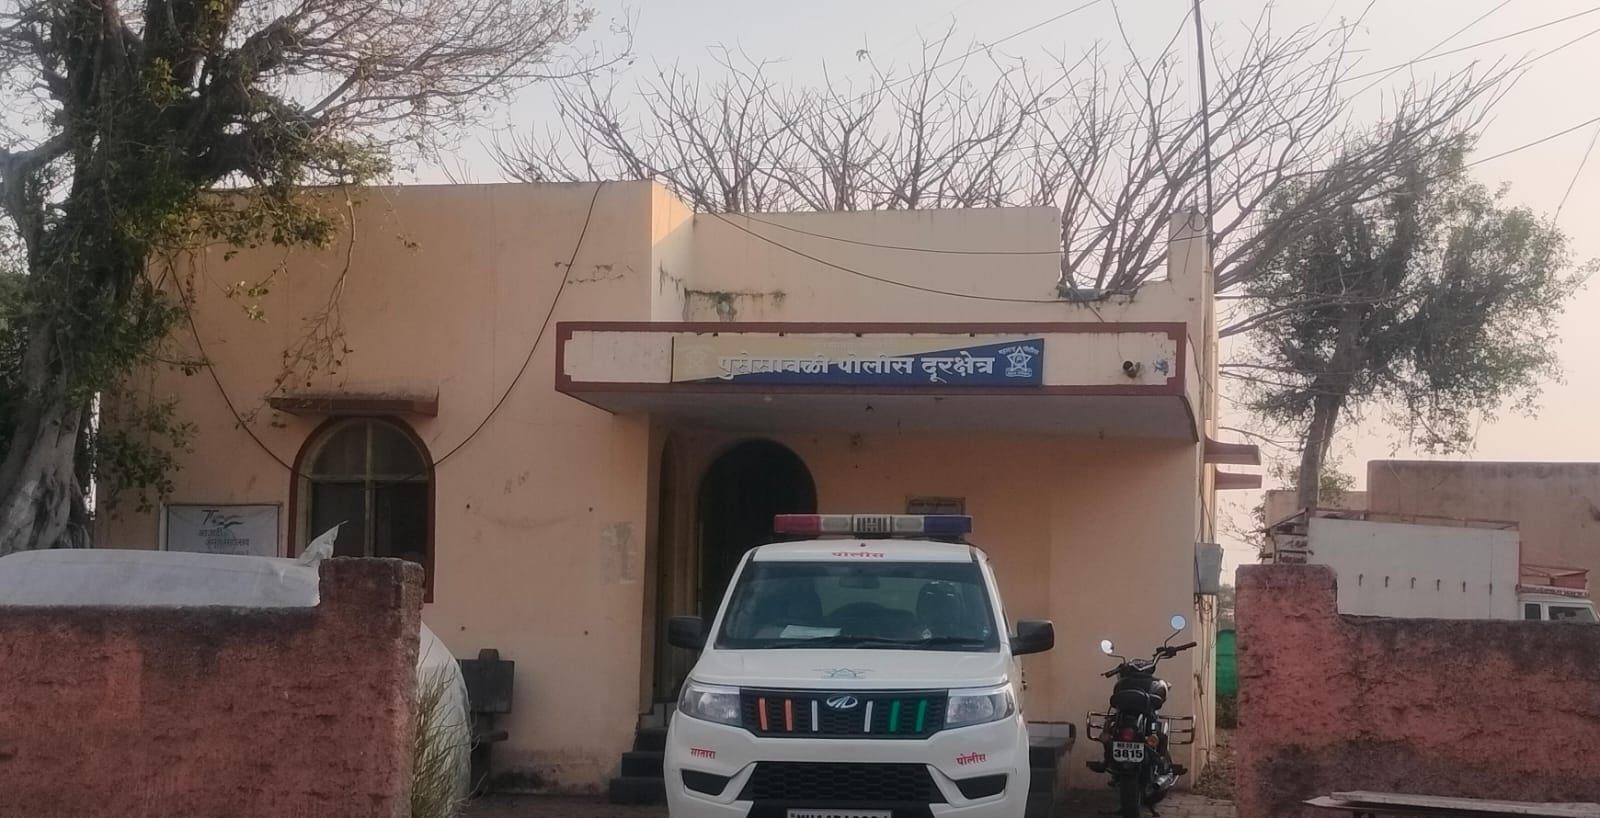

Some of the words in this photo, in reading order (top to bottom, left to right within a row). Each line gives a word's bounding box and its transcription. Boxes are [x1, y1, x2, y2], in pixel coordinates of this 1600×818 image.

[837, 353, 913, 375] पोलीस
[921, 350, 995, 383] दूरक्षेत्र
[690, 747, 716, 760] सातारा
[956, 752, 986, 766] पोलीस
